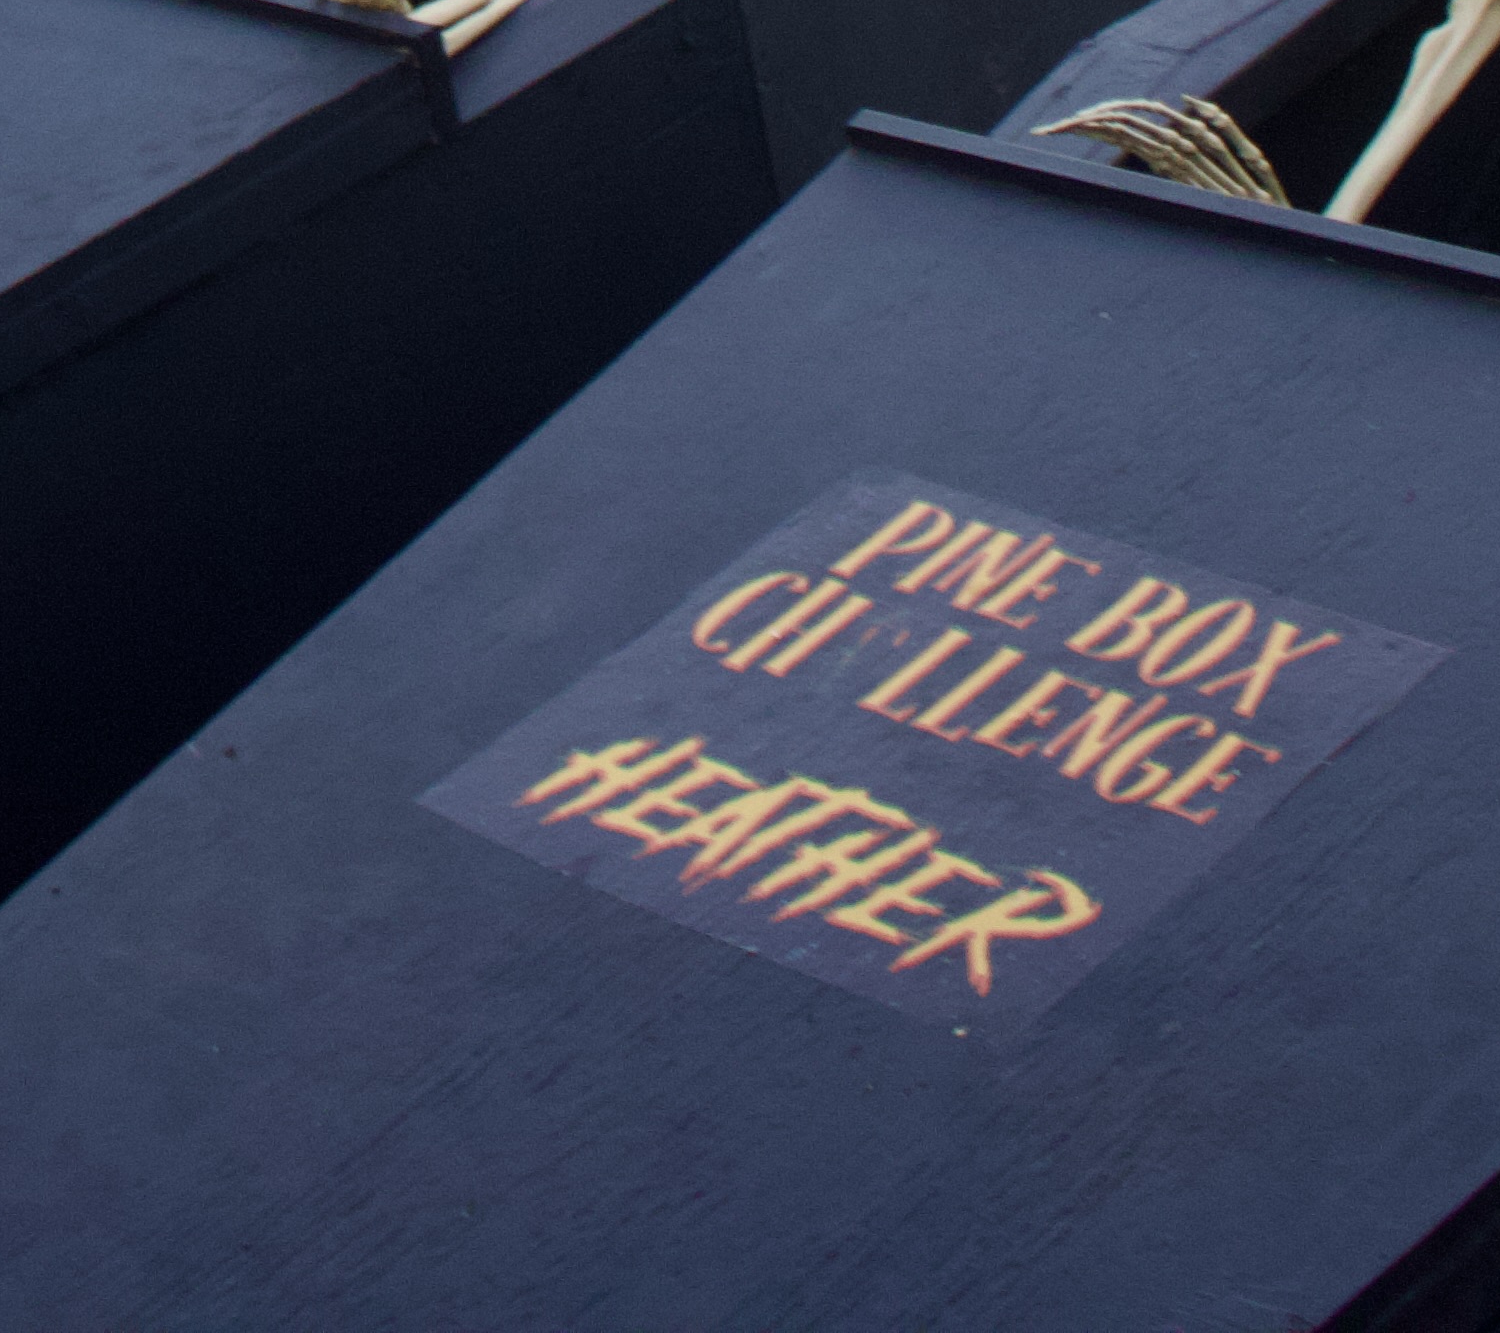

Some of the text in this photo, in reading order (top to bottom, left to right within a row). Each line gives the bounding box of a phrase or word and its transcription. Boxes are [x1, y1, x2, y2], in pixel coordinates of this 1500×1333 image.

[691, 570, 1282, 825] CHLLENGE
[828, 500, 1342, 719] PINE BOX
[513, 736, 1101, 997] HEATHER
